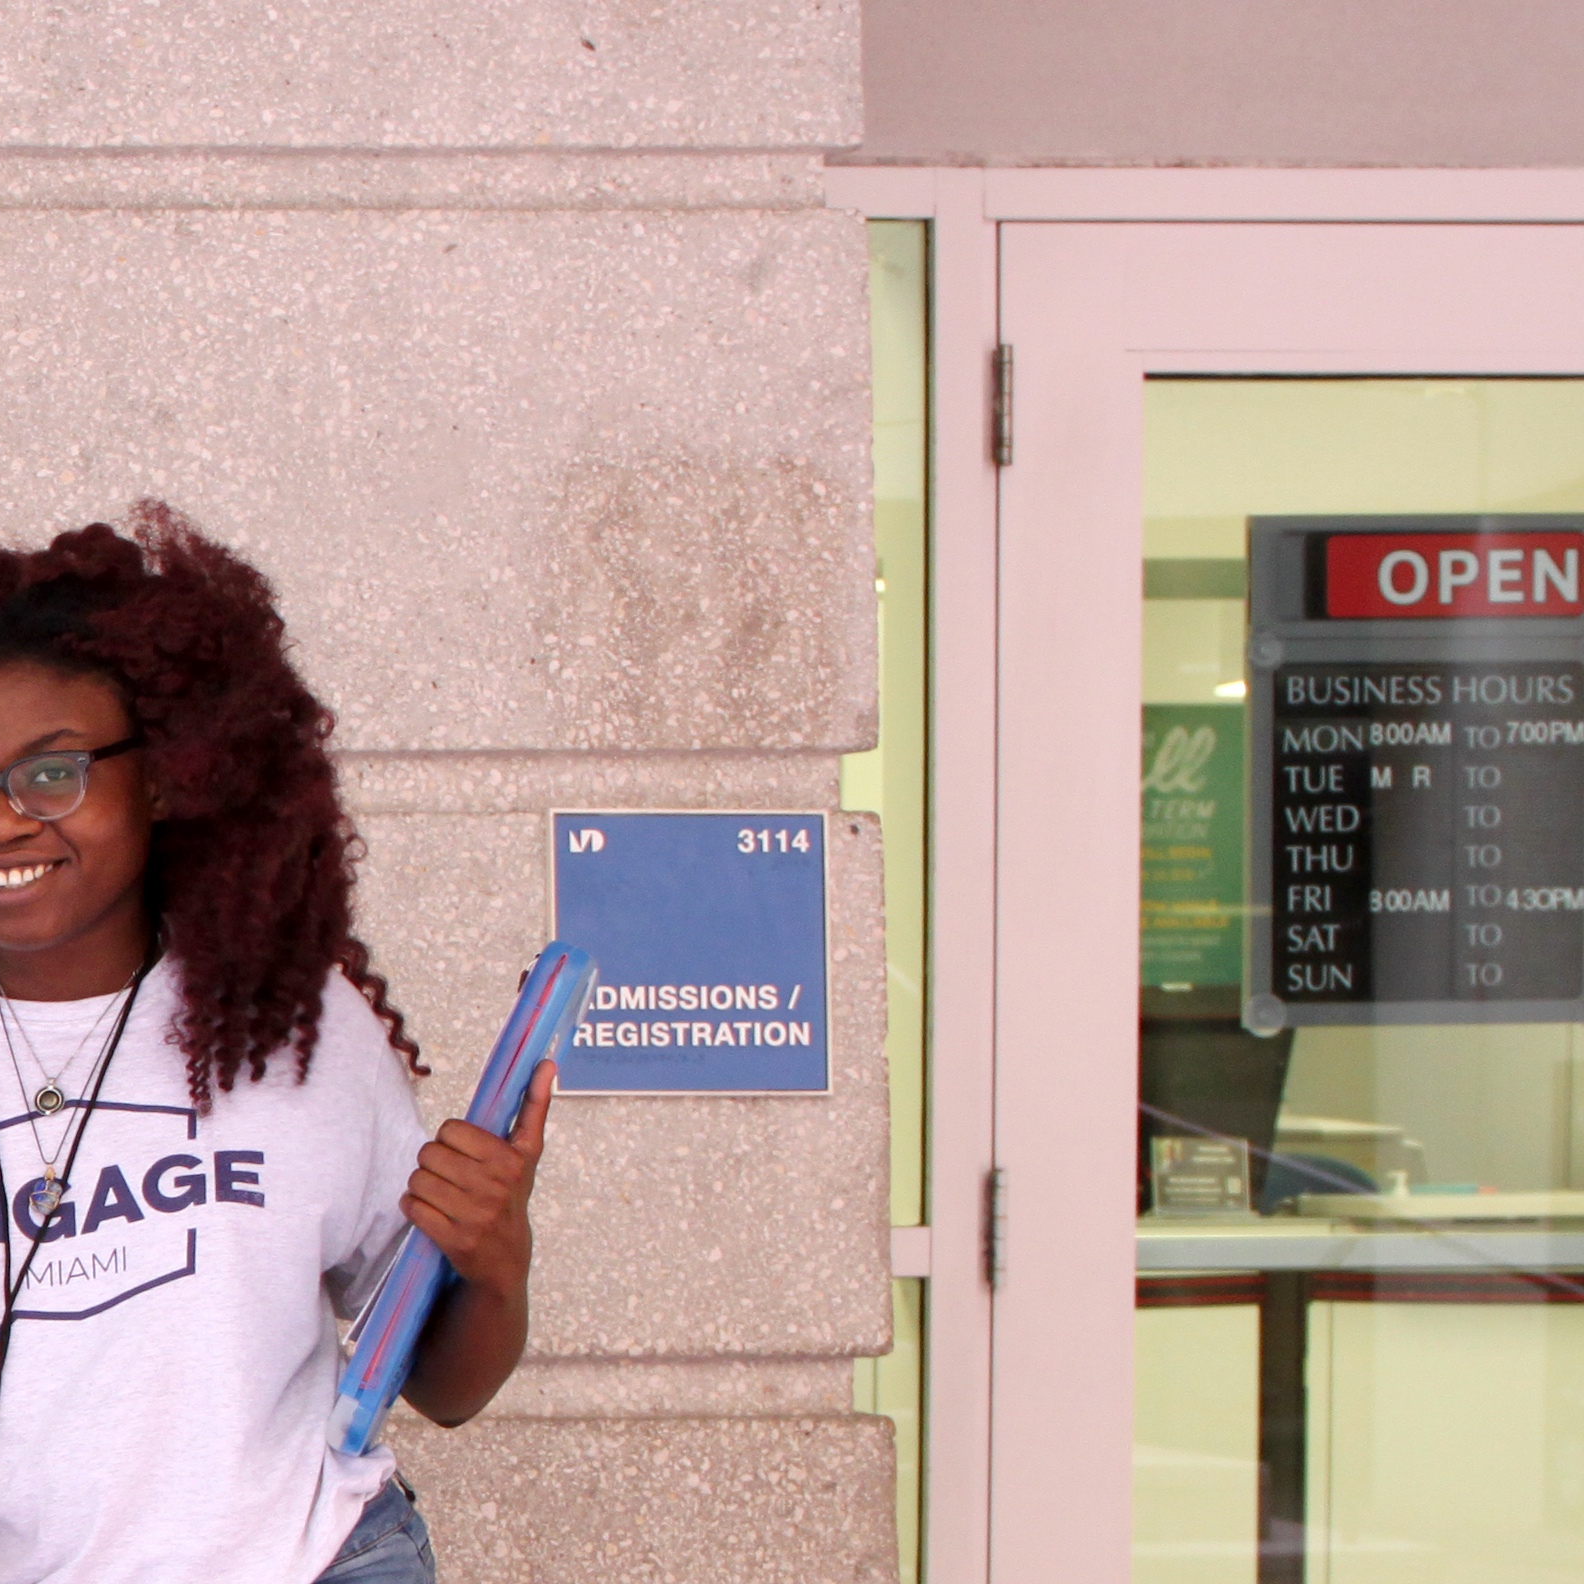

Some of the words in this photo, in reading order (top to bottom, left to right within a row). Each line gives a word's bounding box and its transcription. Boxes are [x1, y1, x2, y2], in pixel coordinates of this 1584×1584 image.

[1377, 548, 1579, 606] OPEN
[1286, 675, 1442, 705] BUSINESS
[1452, 674, 1575, 705] HOURS
[1282, 725, 1364, 754] MON
[1464, 725, 1502, 749] TO
[1283, 764, 1345, 793] TUE
[1370, 765, 1393, 789] M
[1411, 765, 1432, 789] R
[1464, 765, 1502, 789] TO
[1284, 804, 1360, 833] WED
[1464, 804, 1502, 828] TO
[737, 828, 811, 853] 3114
[1285, 844, 1354, 873] THU
[1464, 844, 1502, 868] TO
[1287, 884, 1331, 912] FRI
[1464, 884, 1502, 907] TO
[1287, 924, 1342, 952] SAT
[1464, 923, 1502, 947] TO
[1287, 963, 1354, 991] SUN
[1464, 962, 1502, 986] TO
[588, 984, 779, 1011] DMISSIONS
[572, 1021, 812, 1047] REGISTRATION
[23, 1245, 128, 1290] MIAMI
